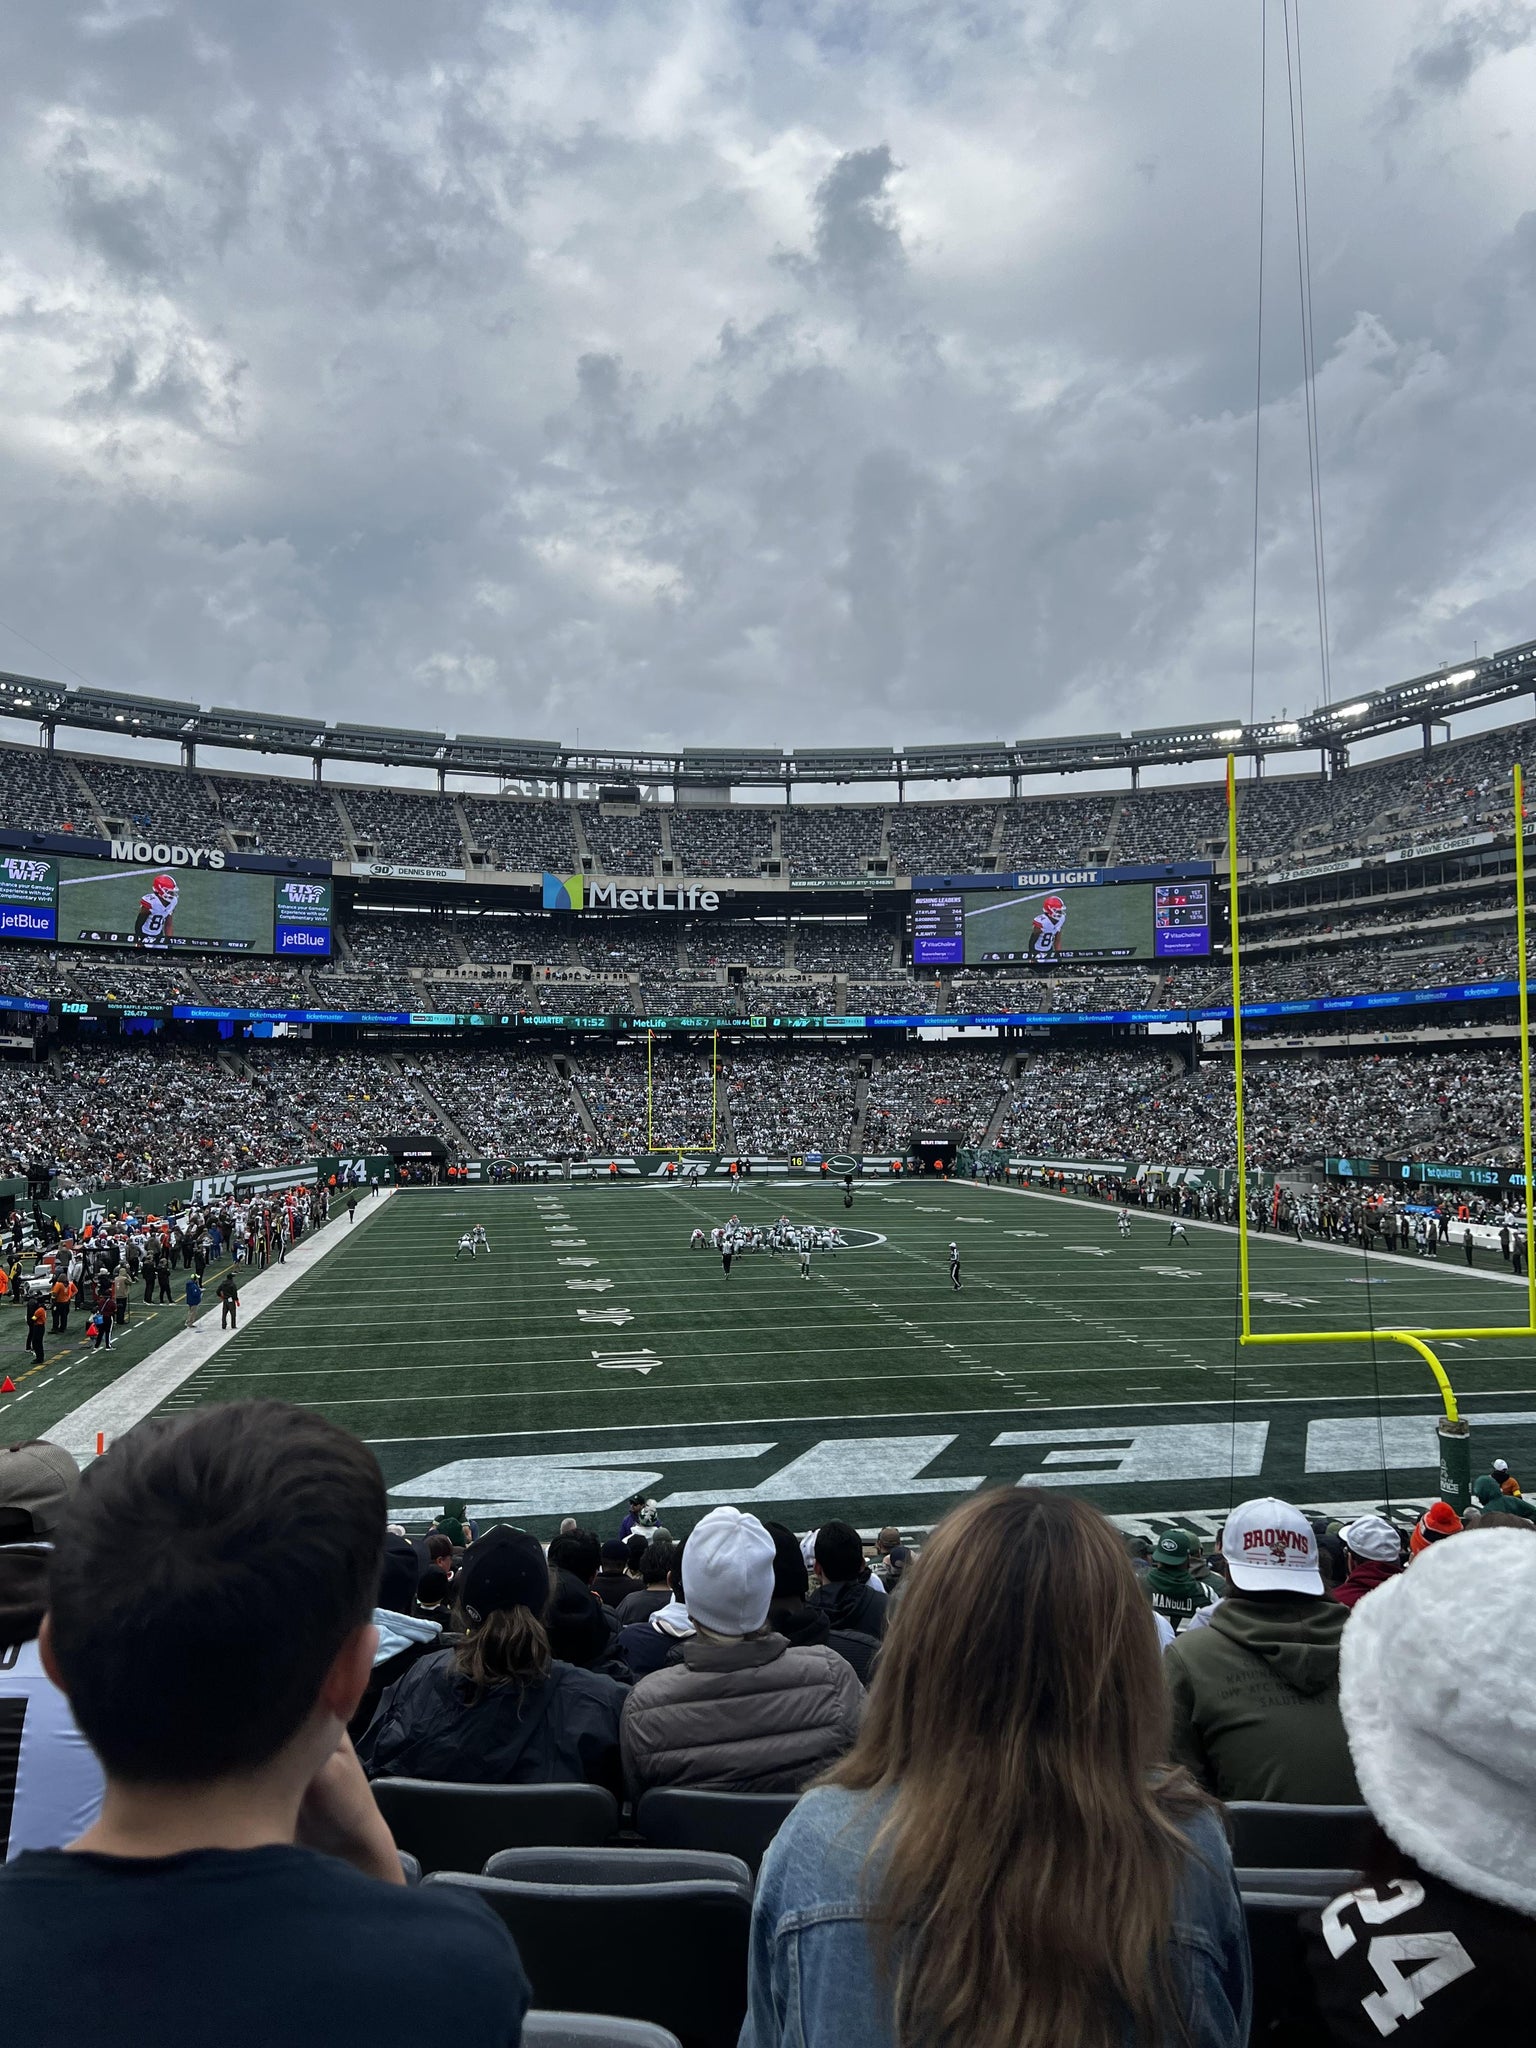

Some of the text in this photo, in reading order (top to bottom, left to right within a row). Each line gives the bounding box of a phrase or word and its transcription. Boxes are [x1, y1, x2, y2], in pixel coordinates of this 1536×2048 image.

[111, 840, 225, 868] MOODY'S
[1400, 837, 1476, 859] 80 WAYNE CHREBET
[1, 858, 37, 870] JETS
[1279, 861, 1349, 880] 32 EMERSON BOOZER
[398, 868, 425, 876] DENNIS
[426, 869, 447, 877] BYRD
[1018, 871, 1097, 886] BUD LIGHT
[281, 883, 314, 894] JETS
[589, 881, 720, 911] MetLife
[1, 913, 49, 929] jetBlue
[282, 932, 325, 947] jetBlue
[1464, 986, 1499, 996] ticketmaster
[61, 1002, 89, 1014] 1:08
[1323, 999, 1353, 1008] ticketmaster
[501, 1015, 508, 1024] 0
[523, 1016, 605, 1027] 1st QUARTER 11:52
[633, 1019, 667, 1027] MetLife
[681, 1018, 695, 1026] 4th
[773, 1018, 780, 1026] 0
[1079, 1014, 1114, 1022] ticketmaster
[791, 1157, 803, 1166] 16
[338, 1159, 367, 1182] 74
[1401, 1165, 1411, 1178] 0
[1427, 1167, 1499, 1184] 1st QUARTER 11:52
[1509, 1173, 1528, 1185] 4TH
[576, 1307, 635, 1323] 20
[591, 1348, 664, 1369] 10
[1243, 1528, 1309, 1554] BROWNS
[1152, 1592, 1193, 1611] MANGOLD
[1321, 1879, 1477, 2038] 24
